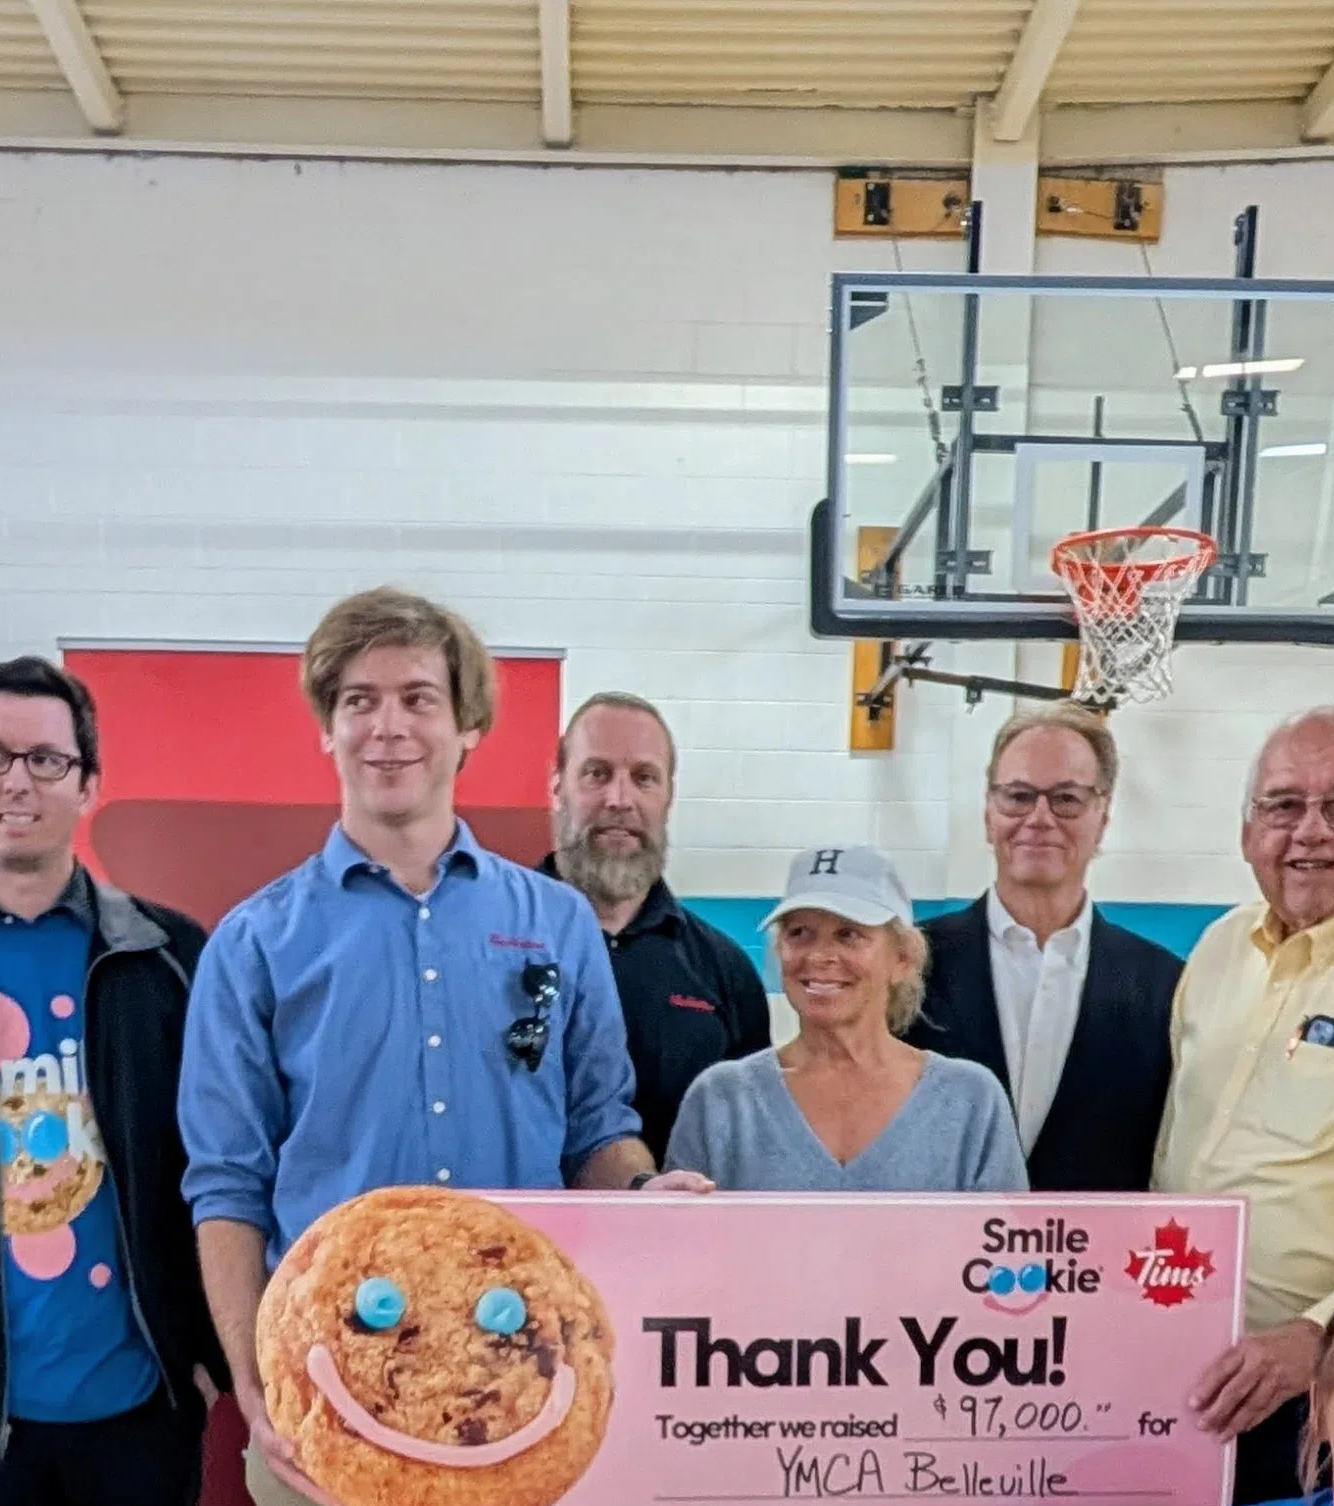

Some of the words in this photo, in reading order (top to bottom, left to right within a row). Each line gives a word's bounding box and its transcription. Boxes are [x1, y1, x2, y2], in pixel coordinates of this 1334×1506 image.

[809, 849, 844, 875] H
[982, 1217, 1090, 1253] Smile
[961, 1257, 1101, 1295] Cookie
[1134, 1248, 1205, 1288] Tims
[642, 1316, 889, 1388] Thank
[899, 1316, 1068, 1387] You!
[654, 1413, 776, 1446] Together
[779, 1418, 816, 1438] we
[819, 1412, 898, 1438] raised
[1137, 1411, 1178, 1437] for
[777, 1445, 884, 1498] YMCA
[903, 1450, 1080, 1498] Belleville
